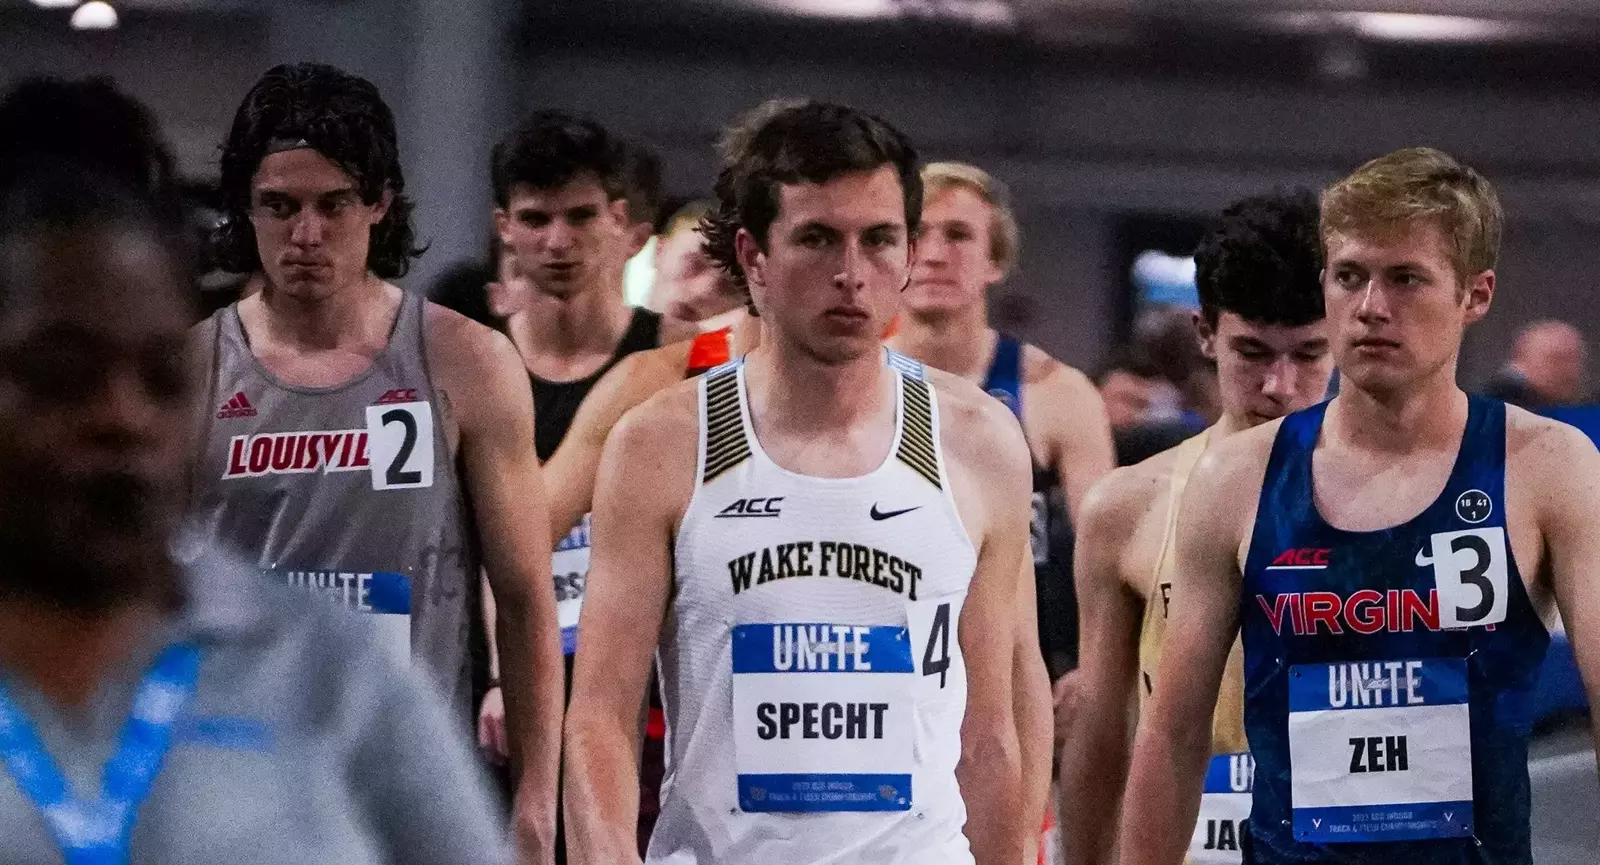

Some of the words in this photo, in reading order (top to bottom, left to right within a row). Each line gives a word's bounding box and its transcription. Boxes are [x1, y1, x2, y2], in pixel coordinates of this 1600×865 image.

[222, 430, 369, 478] LOUISVIL
[381, 408, 422, 485] 2
[715, 497, 786, 517] ACC
[1471, 510, 1476, 519] 1
[1477, 498, 1487, 507] 41
[728, 541, 814, 595] WAKE
[819, 541, 922, 601] FOREST
[1269, 548, 1332, 567] ACC
[1449, 534, 1496, 623] 3
[1256, 589, 1496, 636] VIRGIN
[773, 625, 871, 671] UNITE
[922, 602, 951, 689] 4
[1328, 660, 1424, 708] UNITE
[757, 702, 889, 740] SPECHT
[1349, 735, 1408, 773] ZEH
